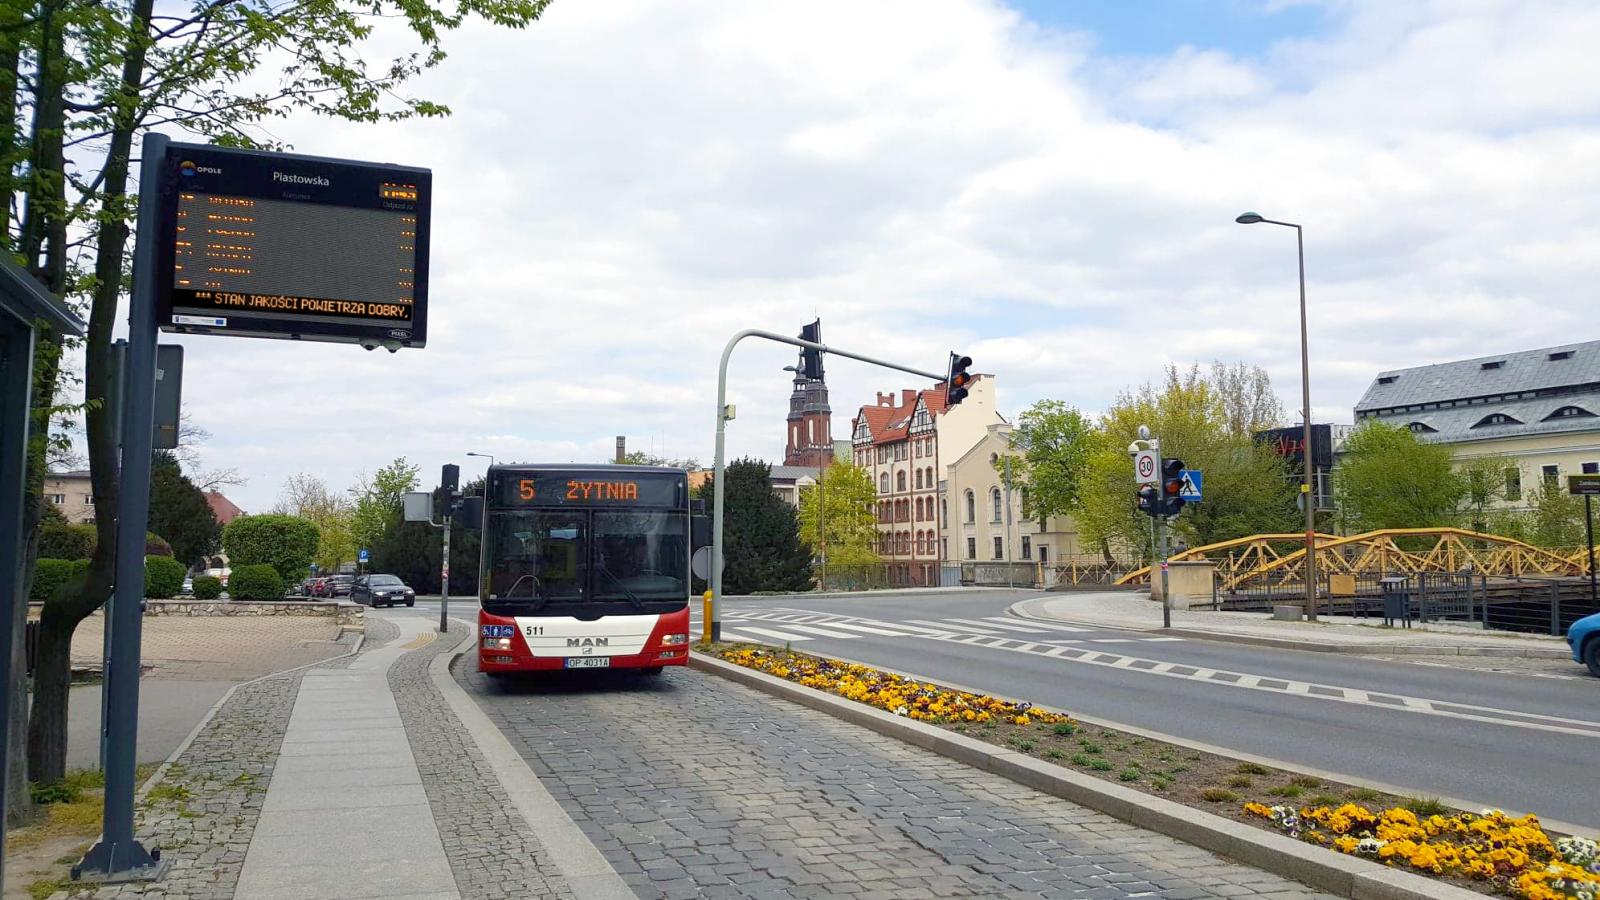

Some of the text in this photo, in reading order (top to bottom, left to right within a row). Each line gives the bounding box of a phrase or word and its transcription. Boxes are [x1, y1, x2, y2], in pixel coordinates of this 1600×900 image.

[197, 166, 222, 175] OPOLE
[273, 171, 330, 187] Piastowska
[214, 293, 246, 305] STAN
[248, 295, 298, 310] JAKOŚCI
[300, 298, 366, 315] POWIETRZA
[1141, 461, 1152, 472] 30
[519, 479, 638, 500] 5 ŻYTNIA
[526, 626, 544, 636] 511
[566, 637, 609, 648] MAN
[569, 658, 608, 668] OP 4031A
